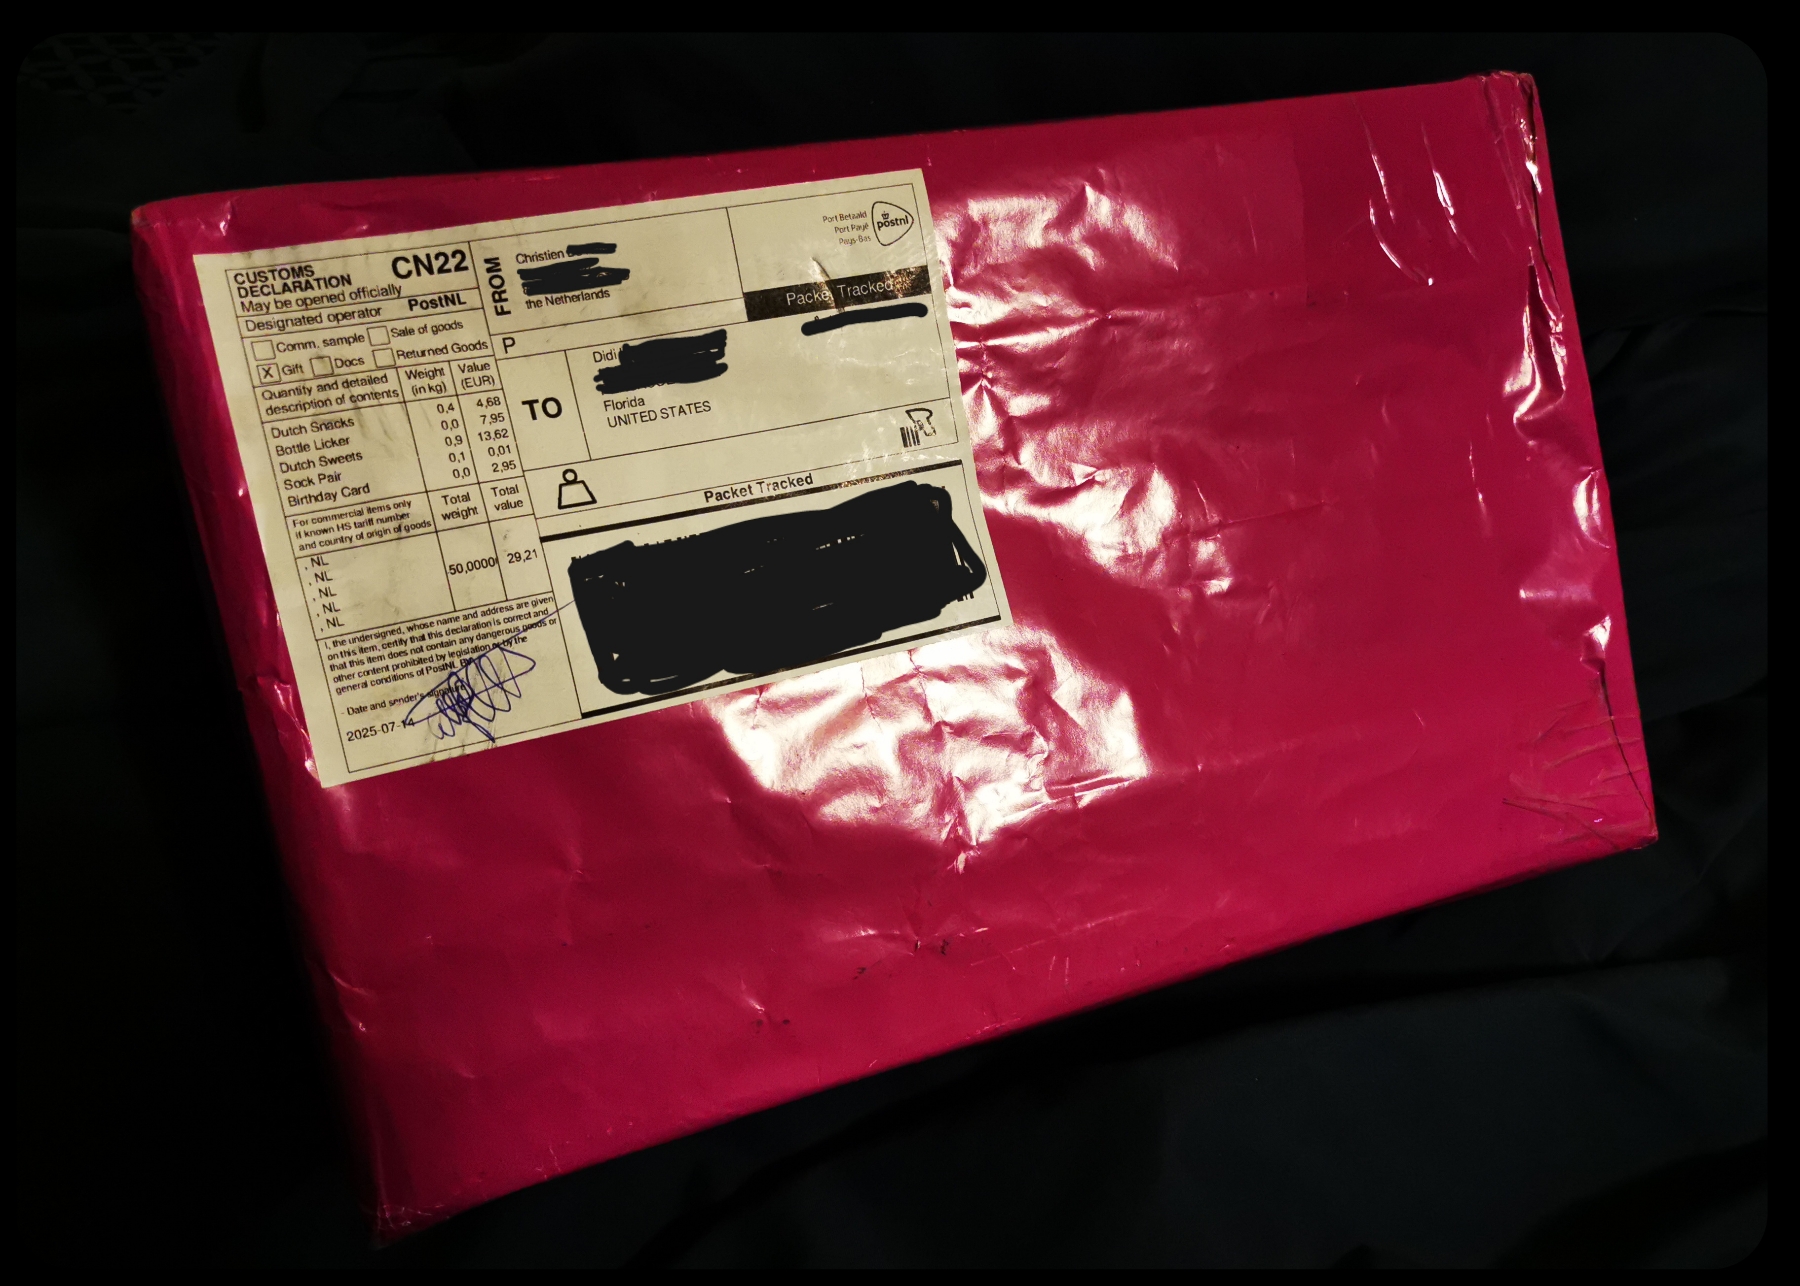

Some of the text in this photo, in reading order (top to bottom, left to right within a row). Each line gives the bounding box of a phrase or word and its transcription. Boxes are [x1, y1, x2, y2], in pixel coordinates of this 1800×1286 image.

[822, 210, 868, 223] Port Betaald
[876, 214, 909, 232] postnl
[834, 224, 850, 234] Port
[391, 249, 469, 280] CN22
[515, 249, 565, 265] Christien
[233, 264, 315, 286] CUSTOMS
[237, 273, 352, 299] DECLARATION
[483, 256, 512, 317] FROM
[786, 280, 894, 306] Packe Tracked
[240, 283, 402, 315] May be opened officially
[407, 291, 467, 312] PostNL
[525, 288, 611, 309] the Netherlands
[245, 306, 382, 333] Designated operator
[390, 319, 465, 339] Sale of goods
[276, 332, 365, 353] Comm. sample
[396, 339, 489, 361] Returned Goods
[502, 336, 516, 354] P
[334, 355, 365, 369] Docs
[593, 347, 618, 363] Didi
[281, 363, 305, 377] Gift
[404, 367, 446, 386] Weight
[456, 361, 491, 375] Value
[261, 372, 388, 402] Quantity and detailed
[411, 380, 448, 397] (in kg)
[460, 374, 496, 391] (EUR)
[265, 387, 400, 417] description of contents
[436, 402, 455, 415] 0,4
[476, 396, 501, 409] 4,68
[521, 396, 563, 421] TO
[603, 395, 646, 412] Florida
[479, 412, 505, 426] 7,95
[607, 400, 712, 428] UNITED STATES
[271, 417, 355, 440] Dutch Snacks
[441, 418, 459, 432] 0,0
[444, 434, 463, 448] 0,9
[477, 428, 509, 442] 13,62
[275, 435, 351, 457] Bottle Licker
[487, 444, 512, 458] 0,01
[279, 451, 363, 475] Dutch Sweets
[448, 451, 466, 464] 0,1
[452, 467, 471, 480] 0,0
[491, 460, 517, 474] 2,95
[283, 470, 342, 491] Sock Pair
[703, 473, 814, 504] Packet Tracked
[287, 483, 371, 509] Birthday Card
[441, 492, 471, 505] Total
[490, 484, 520, 498] Total
[494, 498, 524, 511] value
[292, 499, 412, 529] For commercial items only
[441, 506, 479, 522] weight
[302, 511, 411, 538] known HS tariff number
[298, 519, 432, 551] and country origin goods
[310, 556, 329, 568] NL
[507, 548, 538, 564] 29,21
[326, 617, 345, 629] NL
[332, 595, 555, 647] the undersigned, whose name and address are given
[346, 704, 369, 717] Date
[370, 700, 386, 712] and
